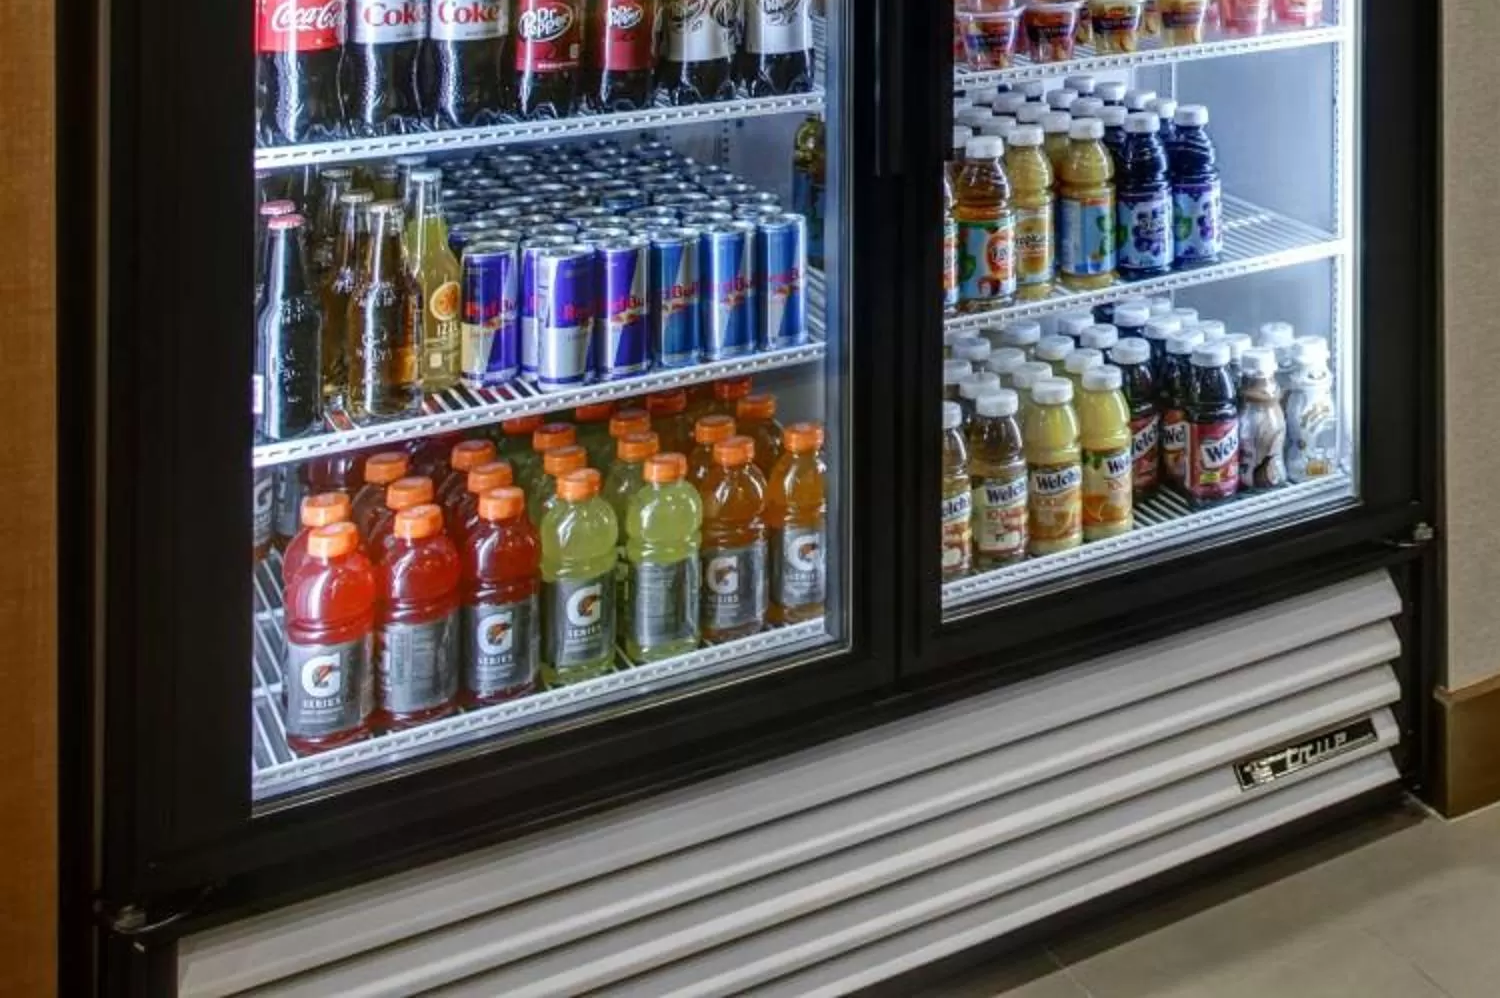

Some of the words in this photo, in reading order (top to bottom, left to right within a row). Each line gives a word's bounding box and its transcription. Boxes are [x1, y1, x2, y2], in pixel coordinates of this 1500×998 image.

[438, 0, 500, 25] Coke
[708, 556, 739, 594] G
[567, 585, 601, 627] G
[478, 612, 513, 655] G
[302, 654, 341, 698] G
